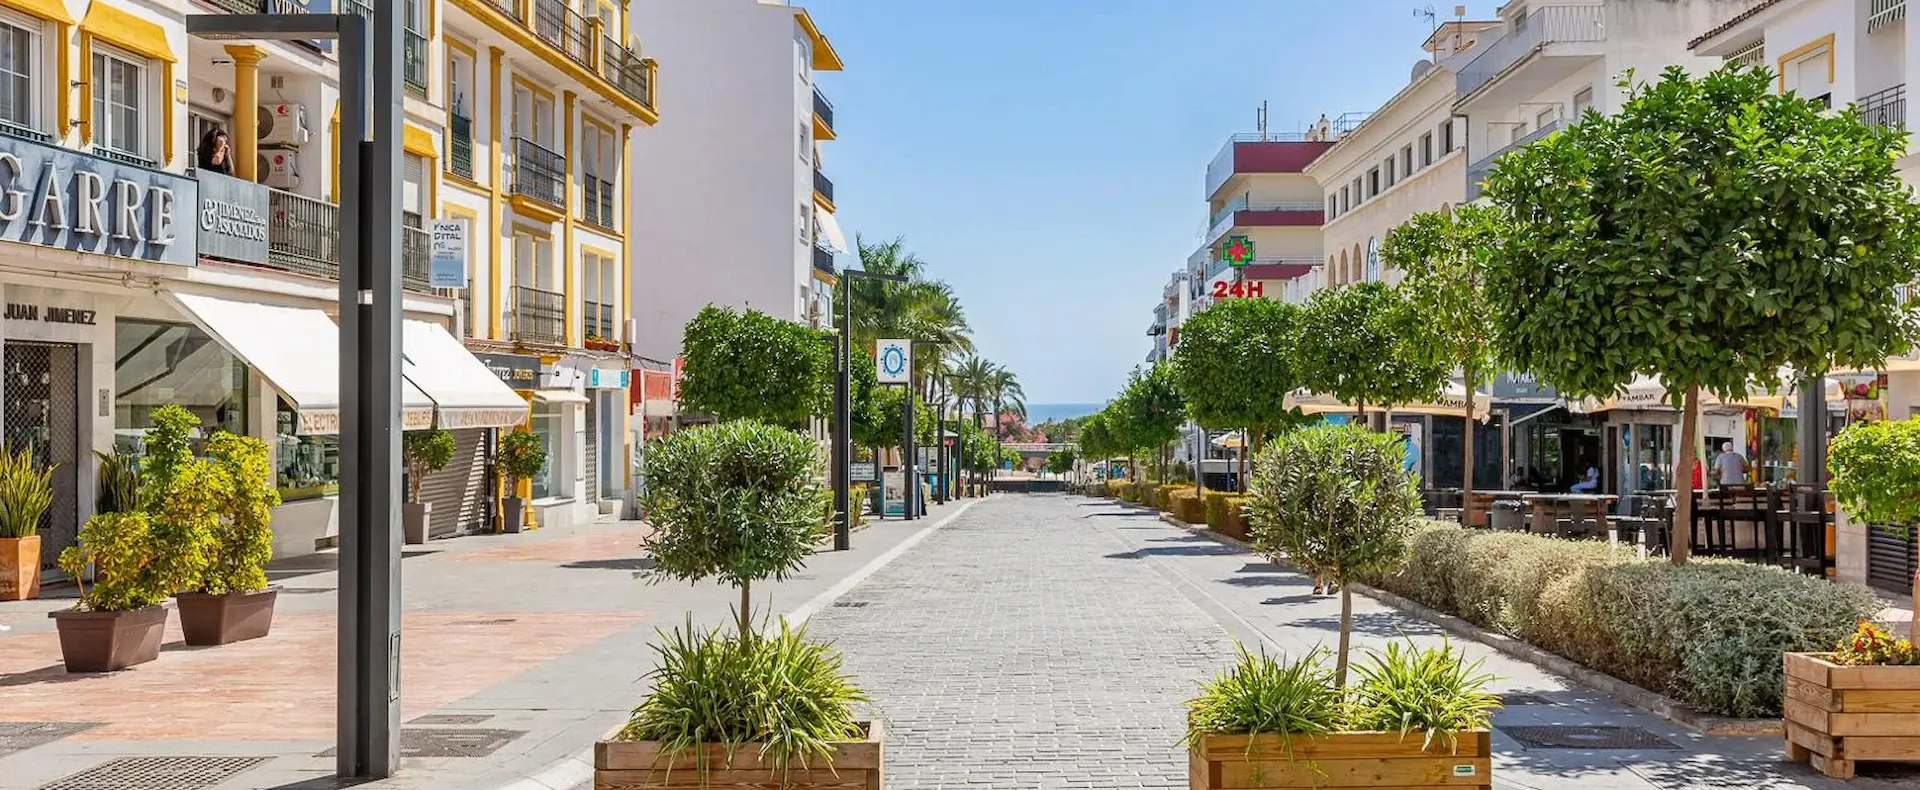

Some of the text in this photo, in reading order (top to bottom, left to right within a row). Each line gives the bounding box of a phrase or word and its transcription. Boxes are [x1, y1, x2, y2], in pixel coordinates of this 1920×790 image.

[215, 216, 266, 241] ASOCIADOS
[1213, 281, 1263, 298] 24H
[4, 303, 96, 325] JUAN JIMENEZ
